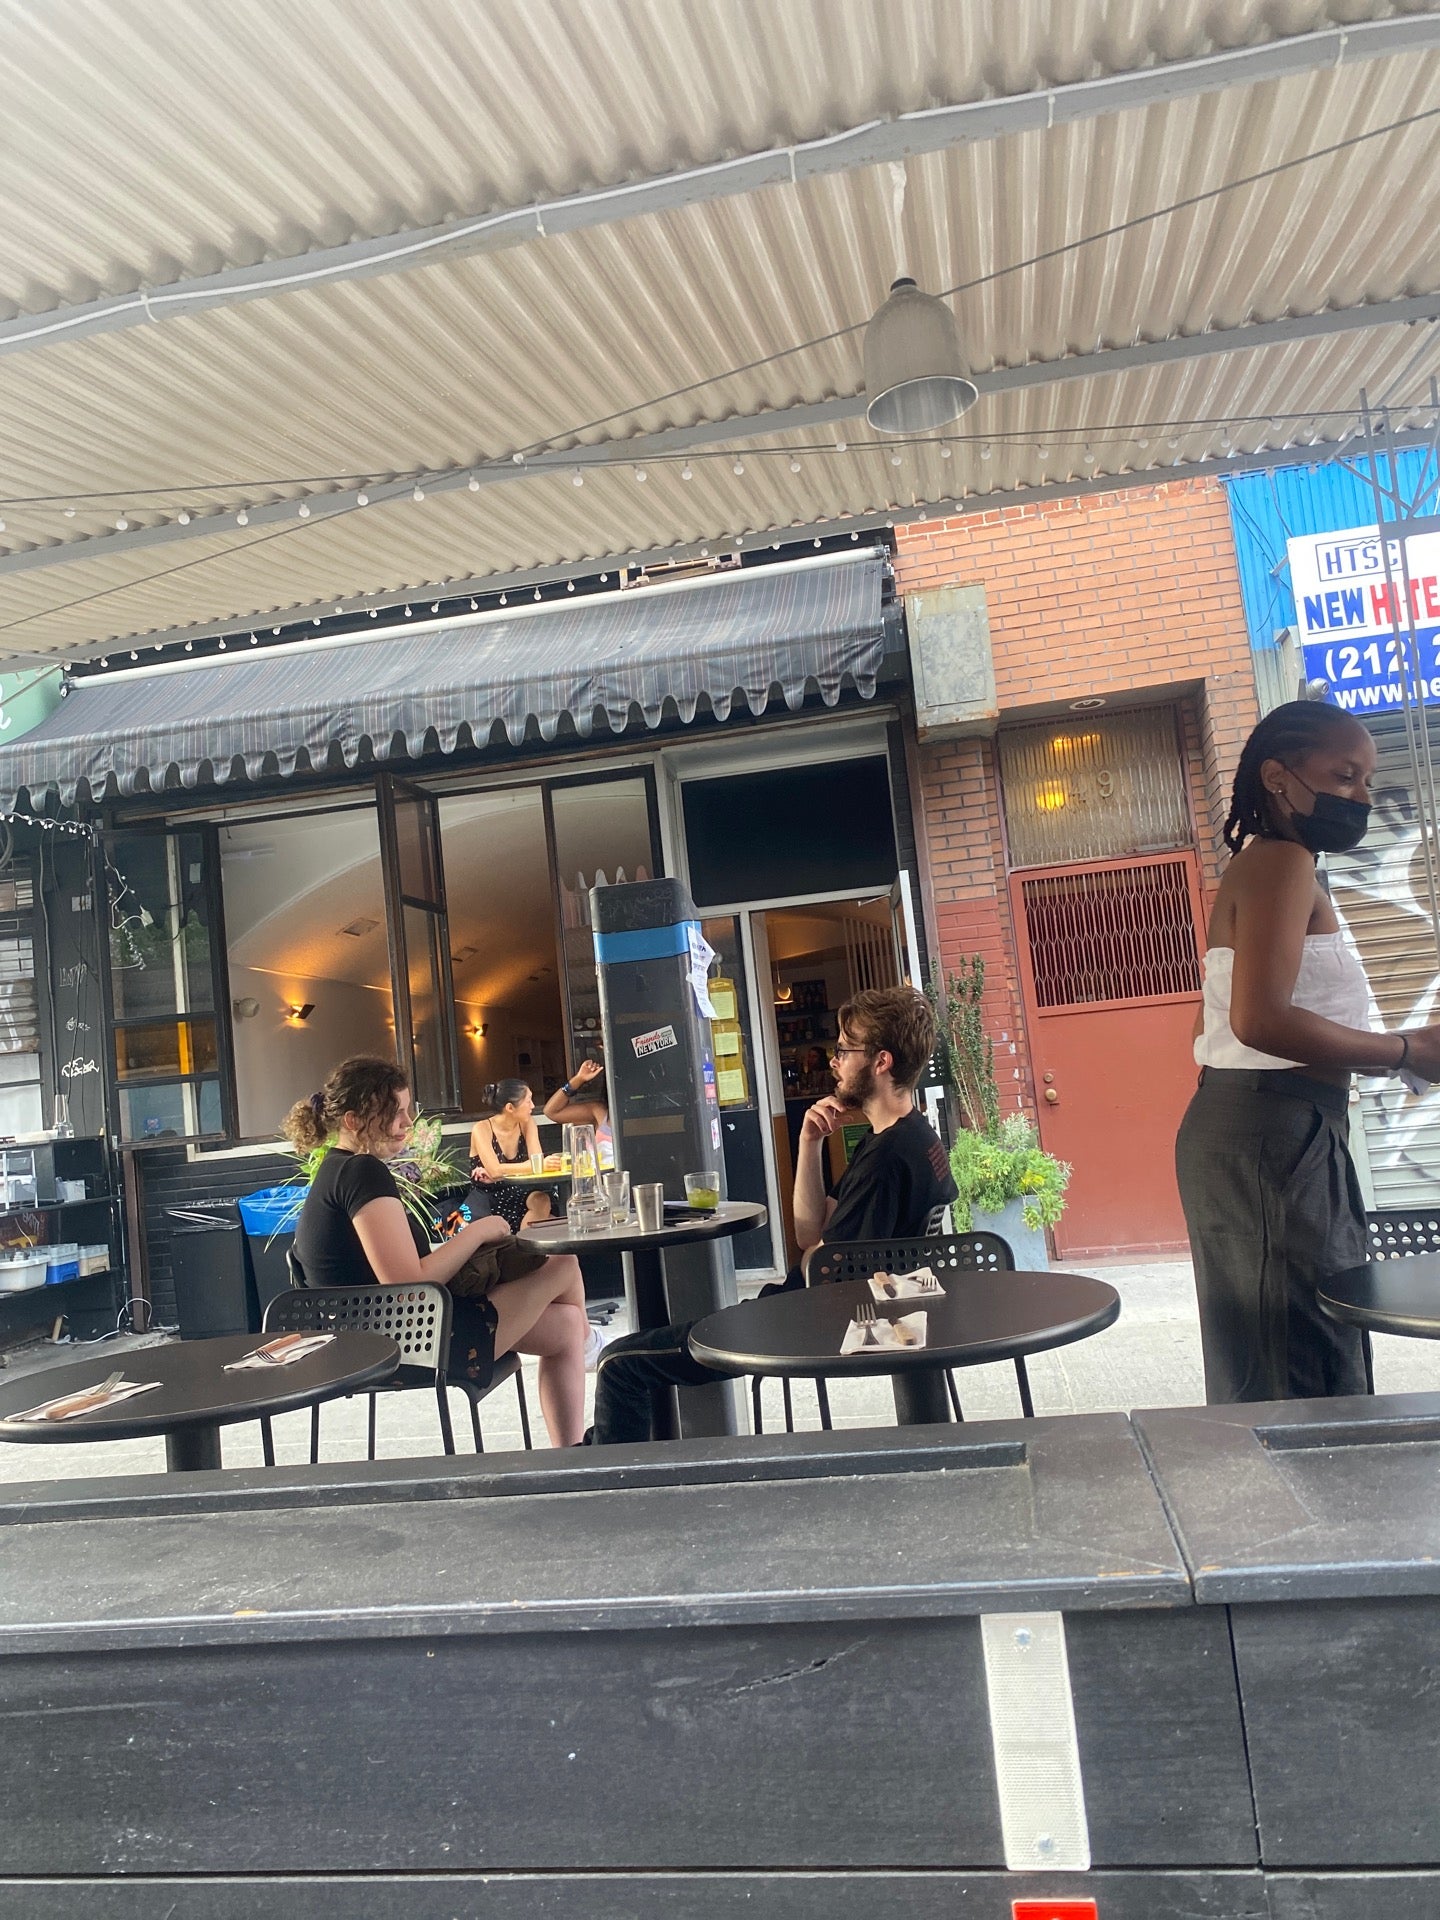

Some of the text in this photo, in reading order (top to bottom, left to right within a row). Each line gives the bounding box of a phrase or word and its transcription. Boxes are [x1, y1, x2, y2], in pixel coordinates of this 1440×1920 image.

[1303, 586, 1365, 631] NEW
[634, 1030, 661, 1048] Friends
[636, 1036, 674, 1057] NEW YORK
